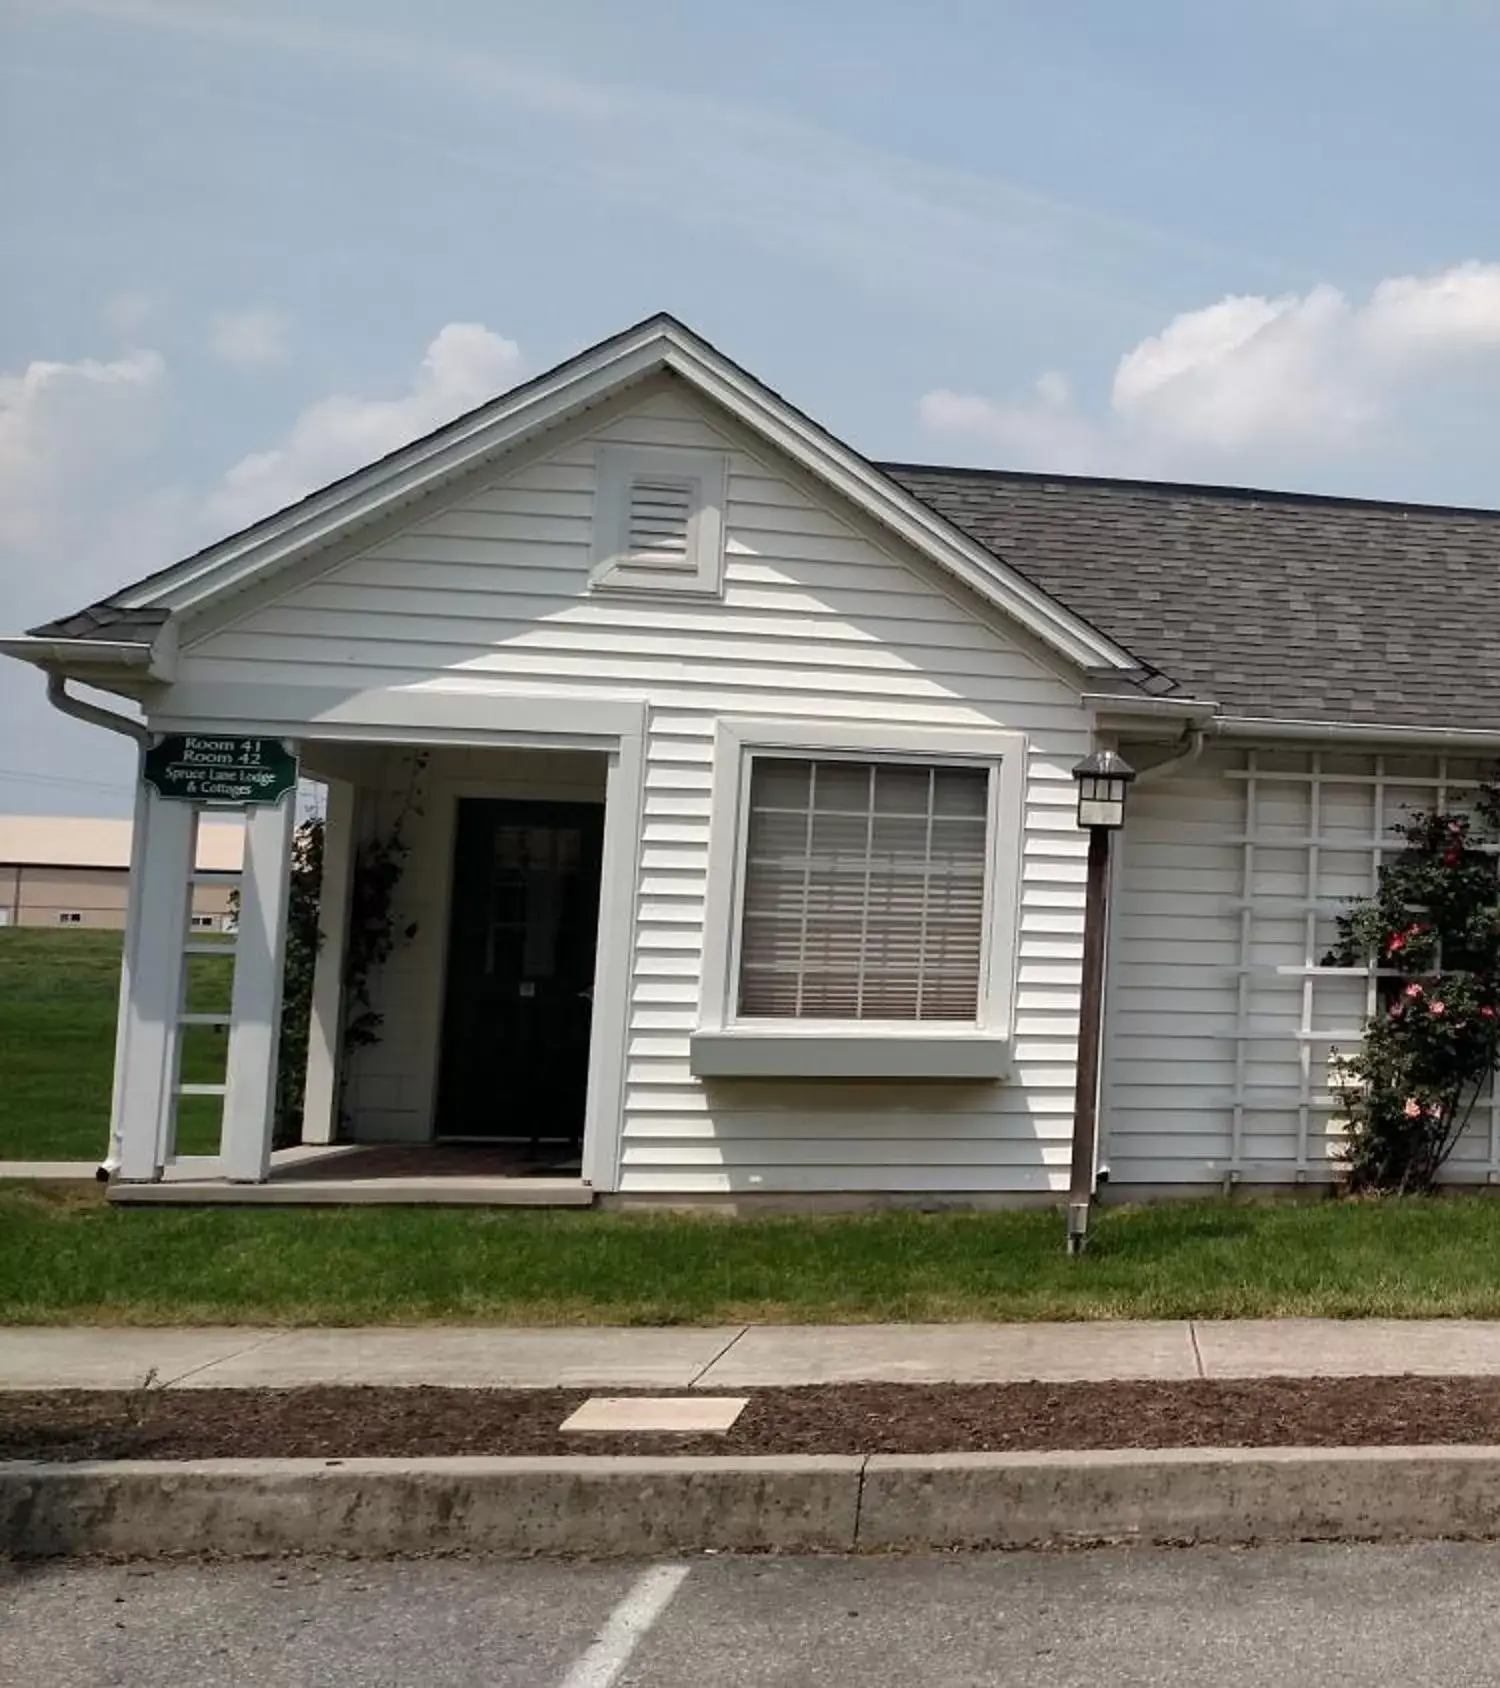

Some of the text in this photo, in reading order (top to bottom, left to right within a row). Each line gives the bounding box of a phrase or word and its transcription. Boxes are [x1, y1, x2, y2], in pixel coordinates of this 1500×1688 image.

[185, 737, 262, 753] Room 41
[183, 749, 262, 765] Room 42
[164, 766, 278, 787] Spruce Lane Lodge
[186, 781, 253, 798] & Cottages
